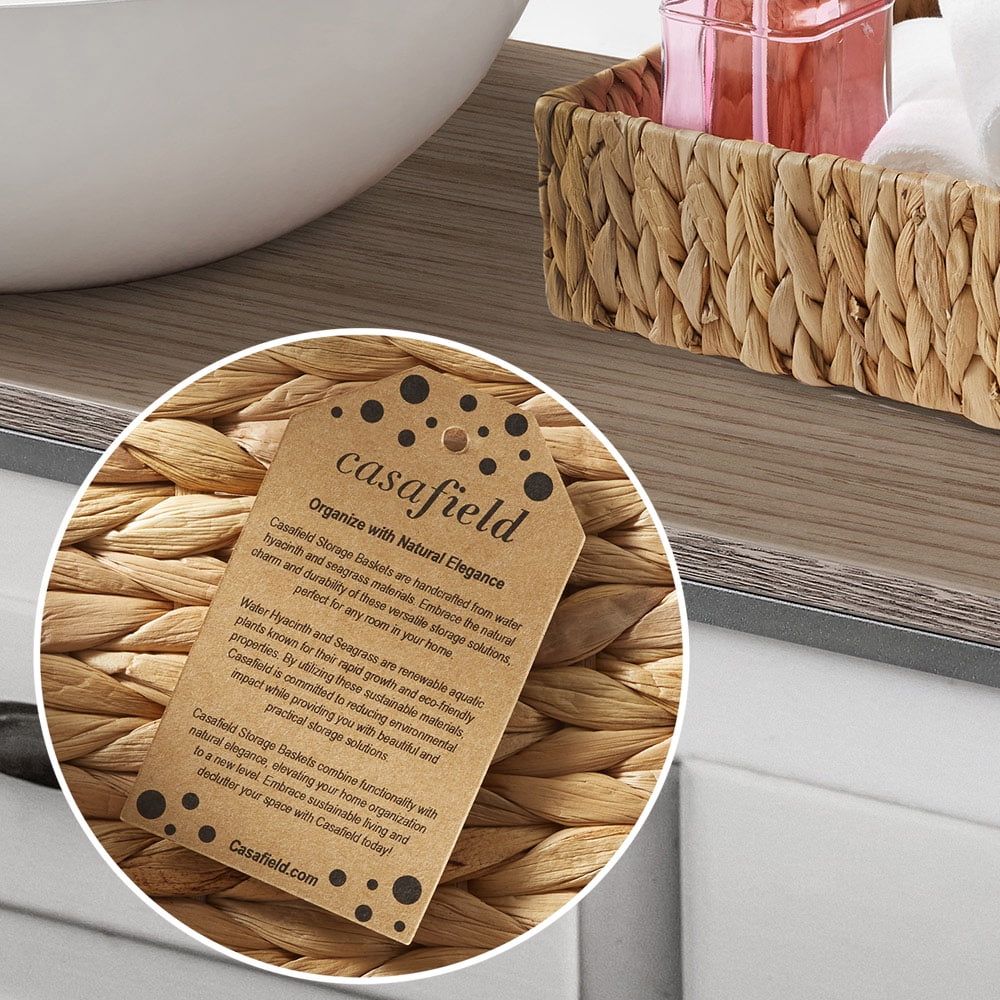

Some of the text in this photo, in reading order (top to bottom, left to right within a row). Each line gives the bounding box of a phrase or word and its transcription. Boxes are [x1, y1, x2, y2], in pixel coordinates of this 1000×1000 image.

[308, 497, 506, 590] Organize with Natural Elegance
[335, 452, 529, 544] casafield
[250, 547, 511, 667] charm and durability of these versatile storage solutions,
[262, 531, 517, 647] hyacinth and seagrass materials. Embrace the natural
[269, 516, 524, 632] Casafield Storage Baskets are handcrafted from water
[292, 585, 454, 660] perfect for any room in your home.
[227, 632, 464, 740] properties. By utilizing these sustainable materials,
[227, 647, 459, 754] Casafield is committed to reducing environmental
[233, 615, 476, 726] plants known for their rapid growth and eco-friendly
[239, 596, 485, 709] Water Hyacinth and Seagrass are renewable aquatic
[192, 707, 439, 821] Casafield Storage Baskets combine functionality with
[230, 667, 442, 765] impact while providing you with beautiful and
[263, 703, 309, 727] practical
[306, 720, 345, 743] storage
[188, 726, 428, 834] natural elegance, elevating your home organization
[193, 745, 205, 757] to
[204, 752, 214, 762] a
[213, 755, 237, 771] new
[262, 774, 307, 801] Embrace
[306, 796, 362, 825] sustainable
[361, 816, 390, 839] living
[388, 831, 412, 846] and
[196, 766, 394, 858] declutter your space with Casafield today!
[228, 838, 319, 887] Casafield.com
